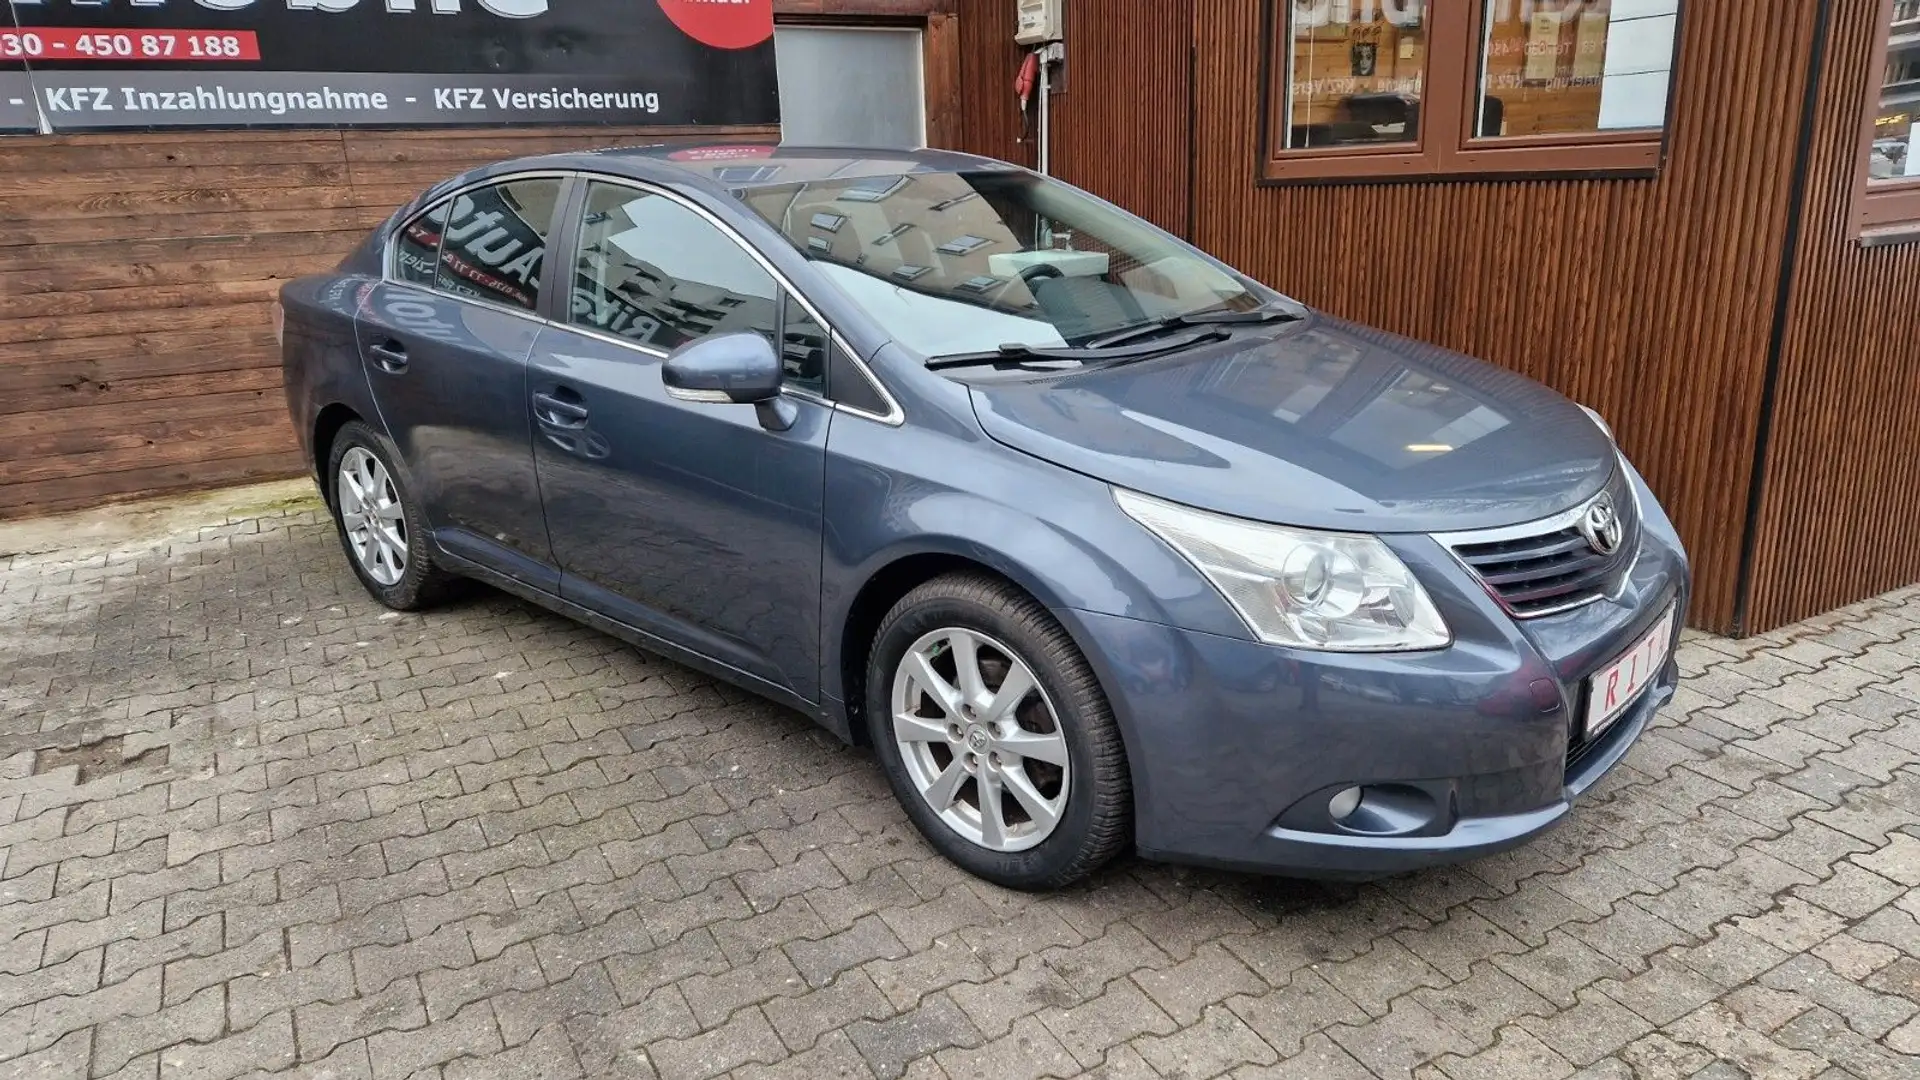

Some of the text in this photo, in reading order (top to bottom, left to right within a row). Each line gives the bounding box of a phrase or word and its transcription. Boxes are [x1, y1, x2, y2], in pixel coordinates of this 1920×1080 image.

[0, 33, 42, 56] 30
[75, 34, 131, 55] 450
[140, 35, 175, 56] 87
[189, 36, 240, 57] 188
[45, 87, 113, 112] KFZ
[120, 86, 388, 115] Inzahlungnahme
[434, 88, 486, 110] KFZ
[493, 87, 660, 113] Versicherung
